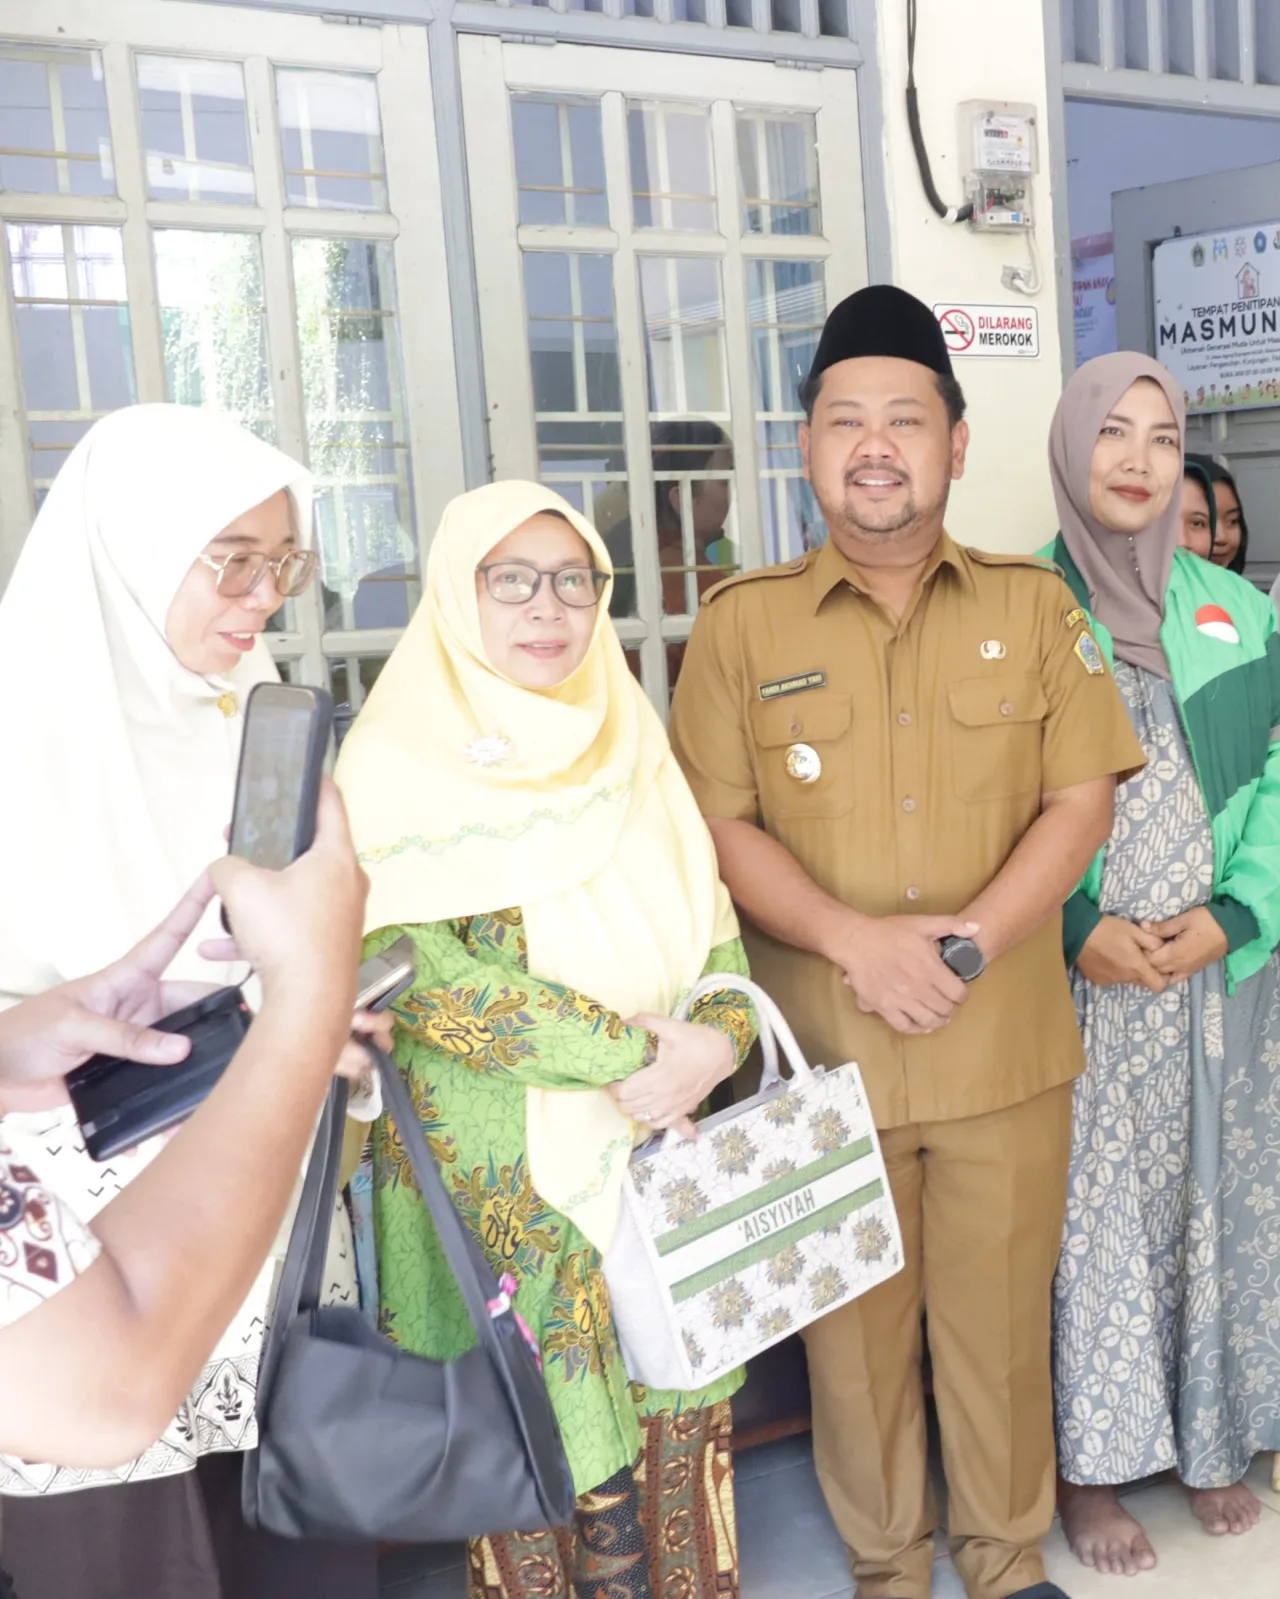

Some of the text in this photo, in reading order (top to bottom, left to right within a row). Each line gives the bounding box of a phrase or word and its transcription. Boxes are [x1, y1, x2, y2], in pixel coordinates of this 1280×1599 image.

[1191, 303, 1229, 318] TEMPAT
[1231, 297, 1280, 313] PENITIPAN
[978, 316, 1033, 330] DILARANG
[979, 332, 1033, 346] MEROKOK
